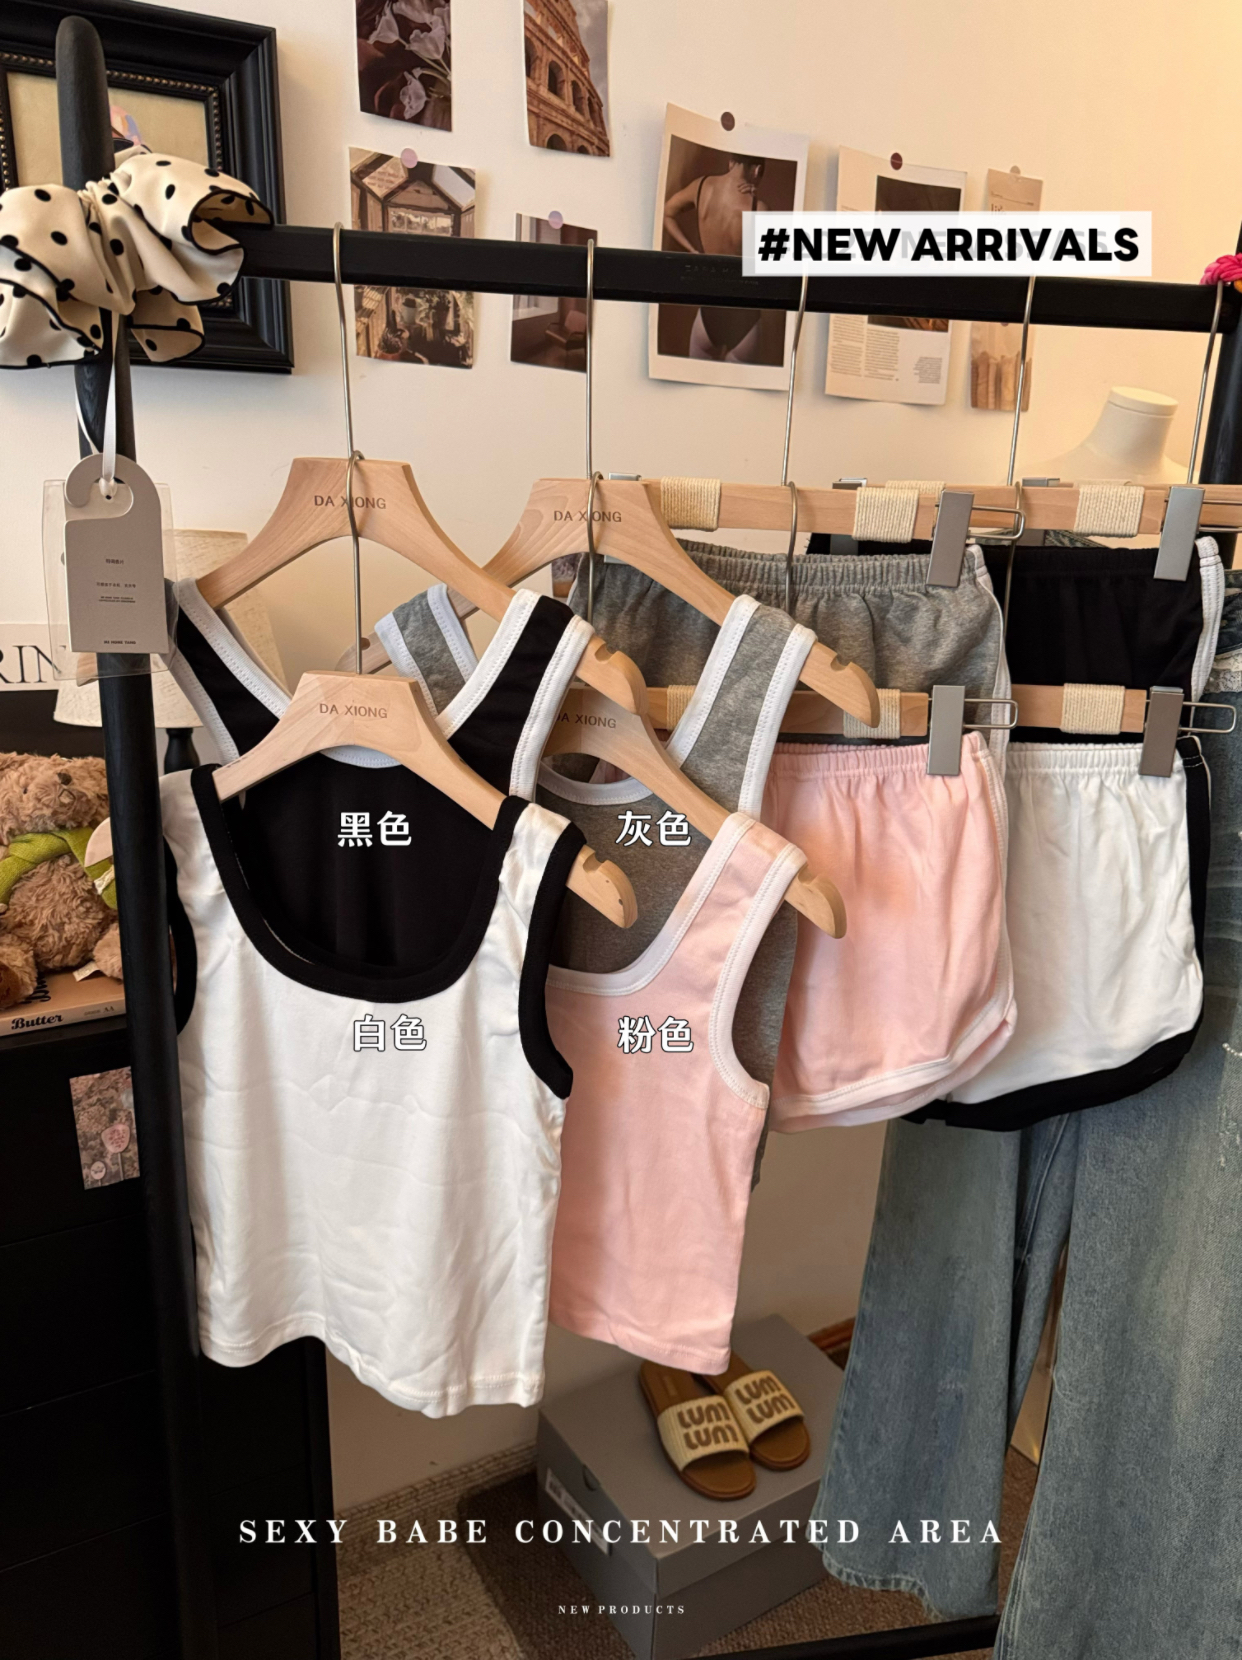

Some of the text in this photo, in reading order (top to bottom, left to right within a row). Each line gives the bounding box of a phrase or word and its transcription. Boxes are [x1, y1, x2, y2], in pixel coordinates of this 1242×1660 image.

[314, 495, 335, 507] DA
[553, 510, 622, 523] DA XONG
[319, 703, 388, 719] DA XIONG
[575, 713, 617, 729] XIONG
[11, 1013, 64, 1031] Butter
